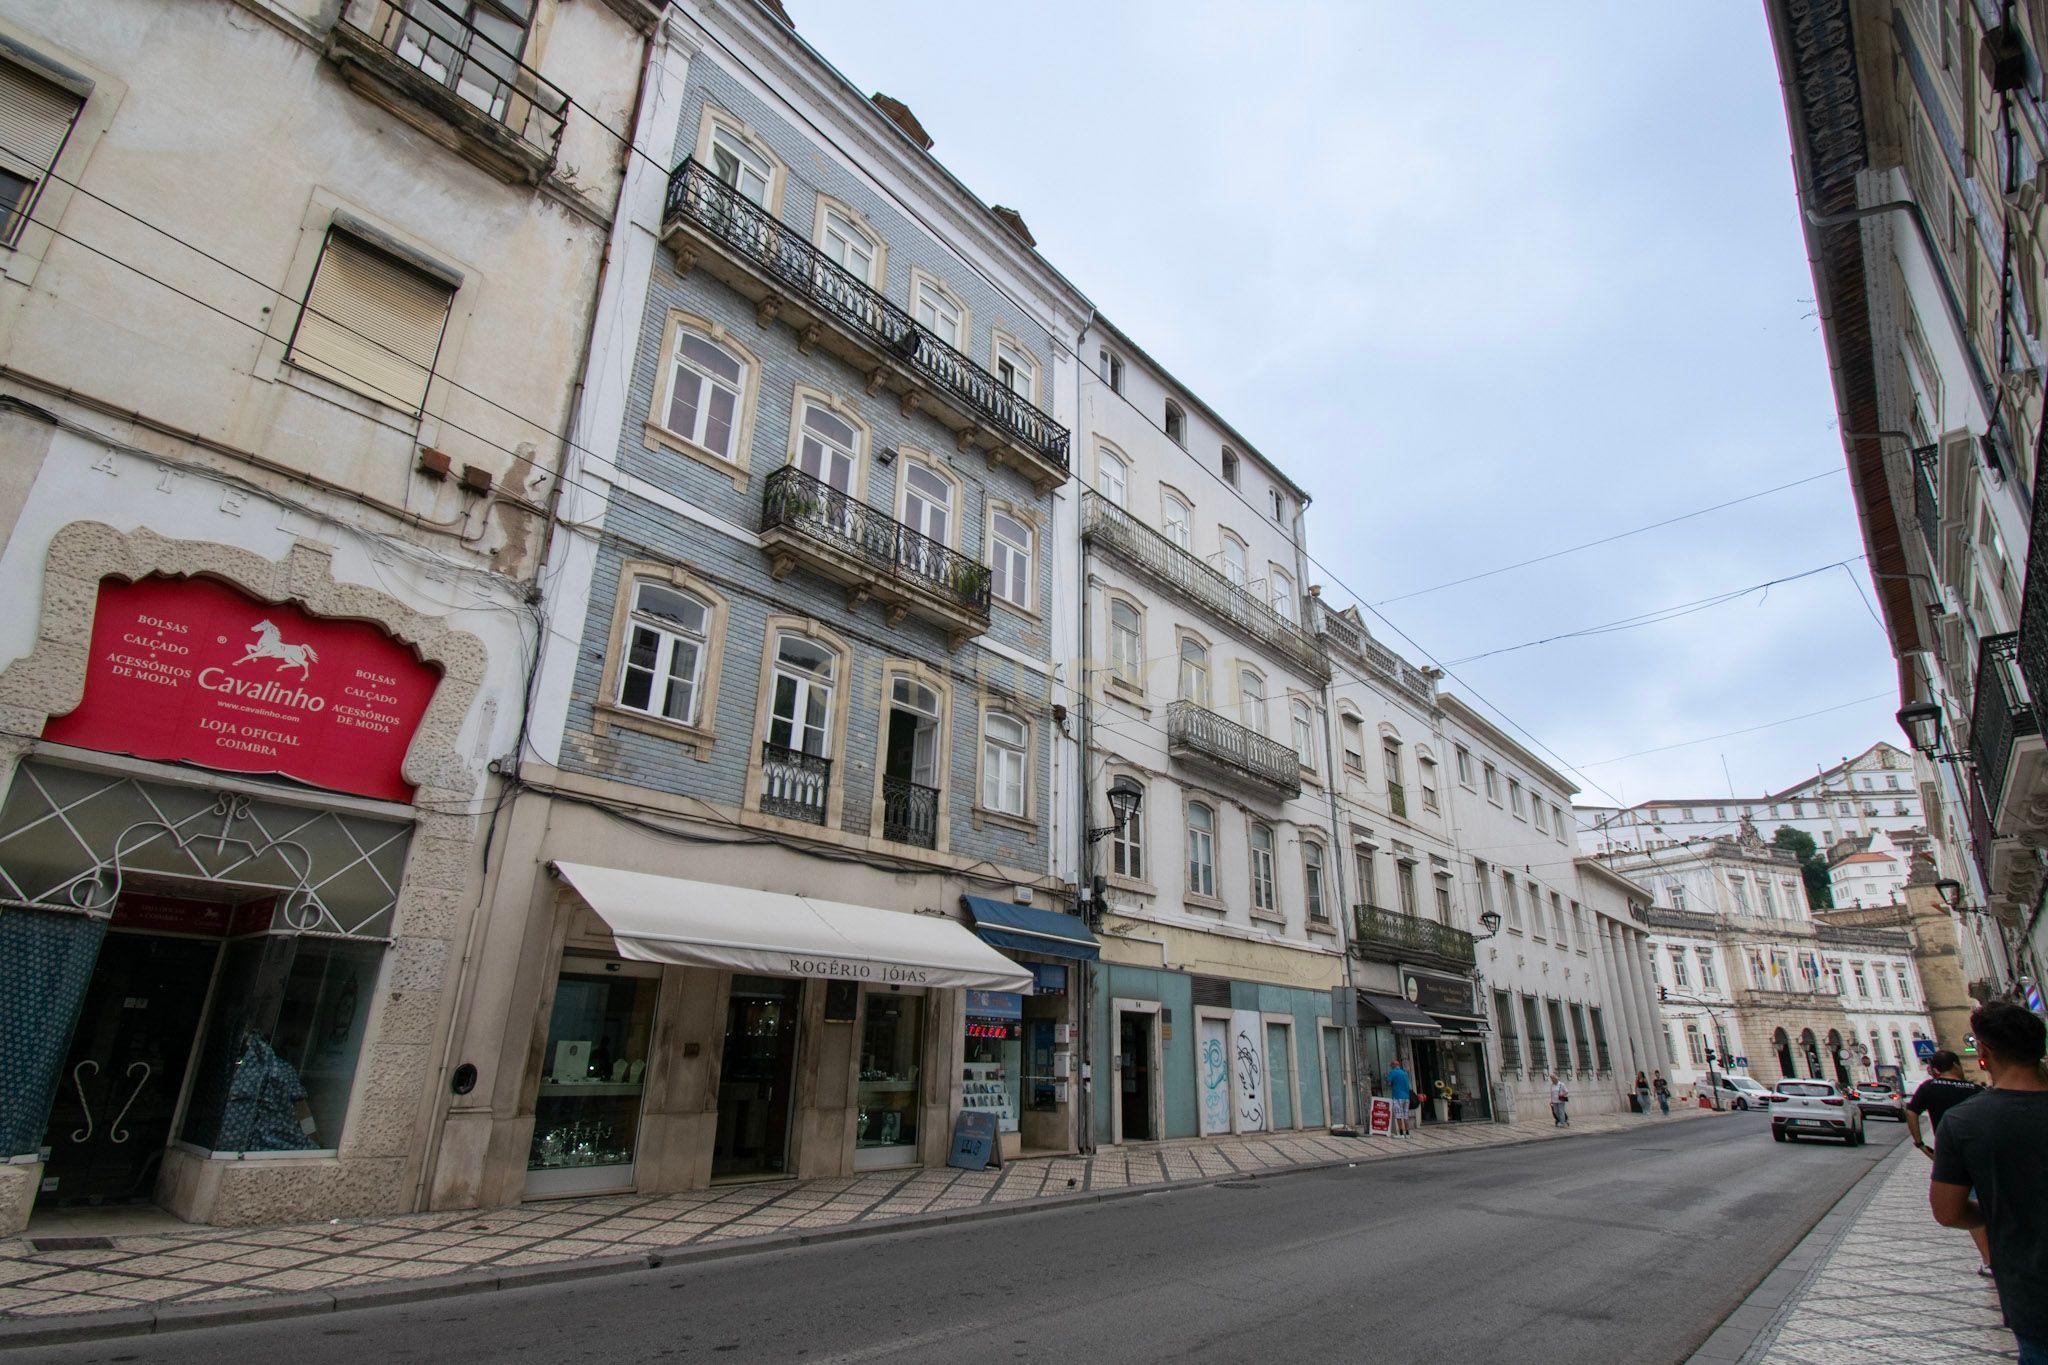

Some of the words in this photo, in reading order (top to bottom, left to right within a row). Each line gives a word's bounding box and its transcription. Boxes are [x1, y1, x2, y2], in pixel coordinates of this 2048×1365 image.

[138, 614, 189, 634] BOLSAS
[123, 633, 189, 655] CALÇADO
[106, 653, 192, 678] ACESSÓRIOS
[112, 665, 133, 677] DE
[135, 670, 178, 687] MODA
[355, 669, 396, 686] BOLSAS
[198, 667, 325, 712] Cavalinho
[344, 686, 397, 705] CALÇADO
[217, 700, 300, 723] www.cavalinho.com
[331, 704, 400, 725] ACESSÓRIOS
[200, 718, 237, 734] LOJA
[241, 726, 301, 746] OFICIAL
[336, 715, 353, 725] DE
[355, 719, 390, 733] MODA
[216, 737, 278, 756] COIMBRA
[790, 959, 870, 978] ROGÉRIO
[882, 966, 926, 983] JÓIAS
